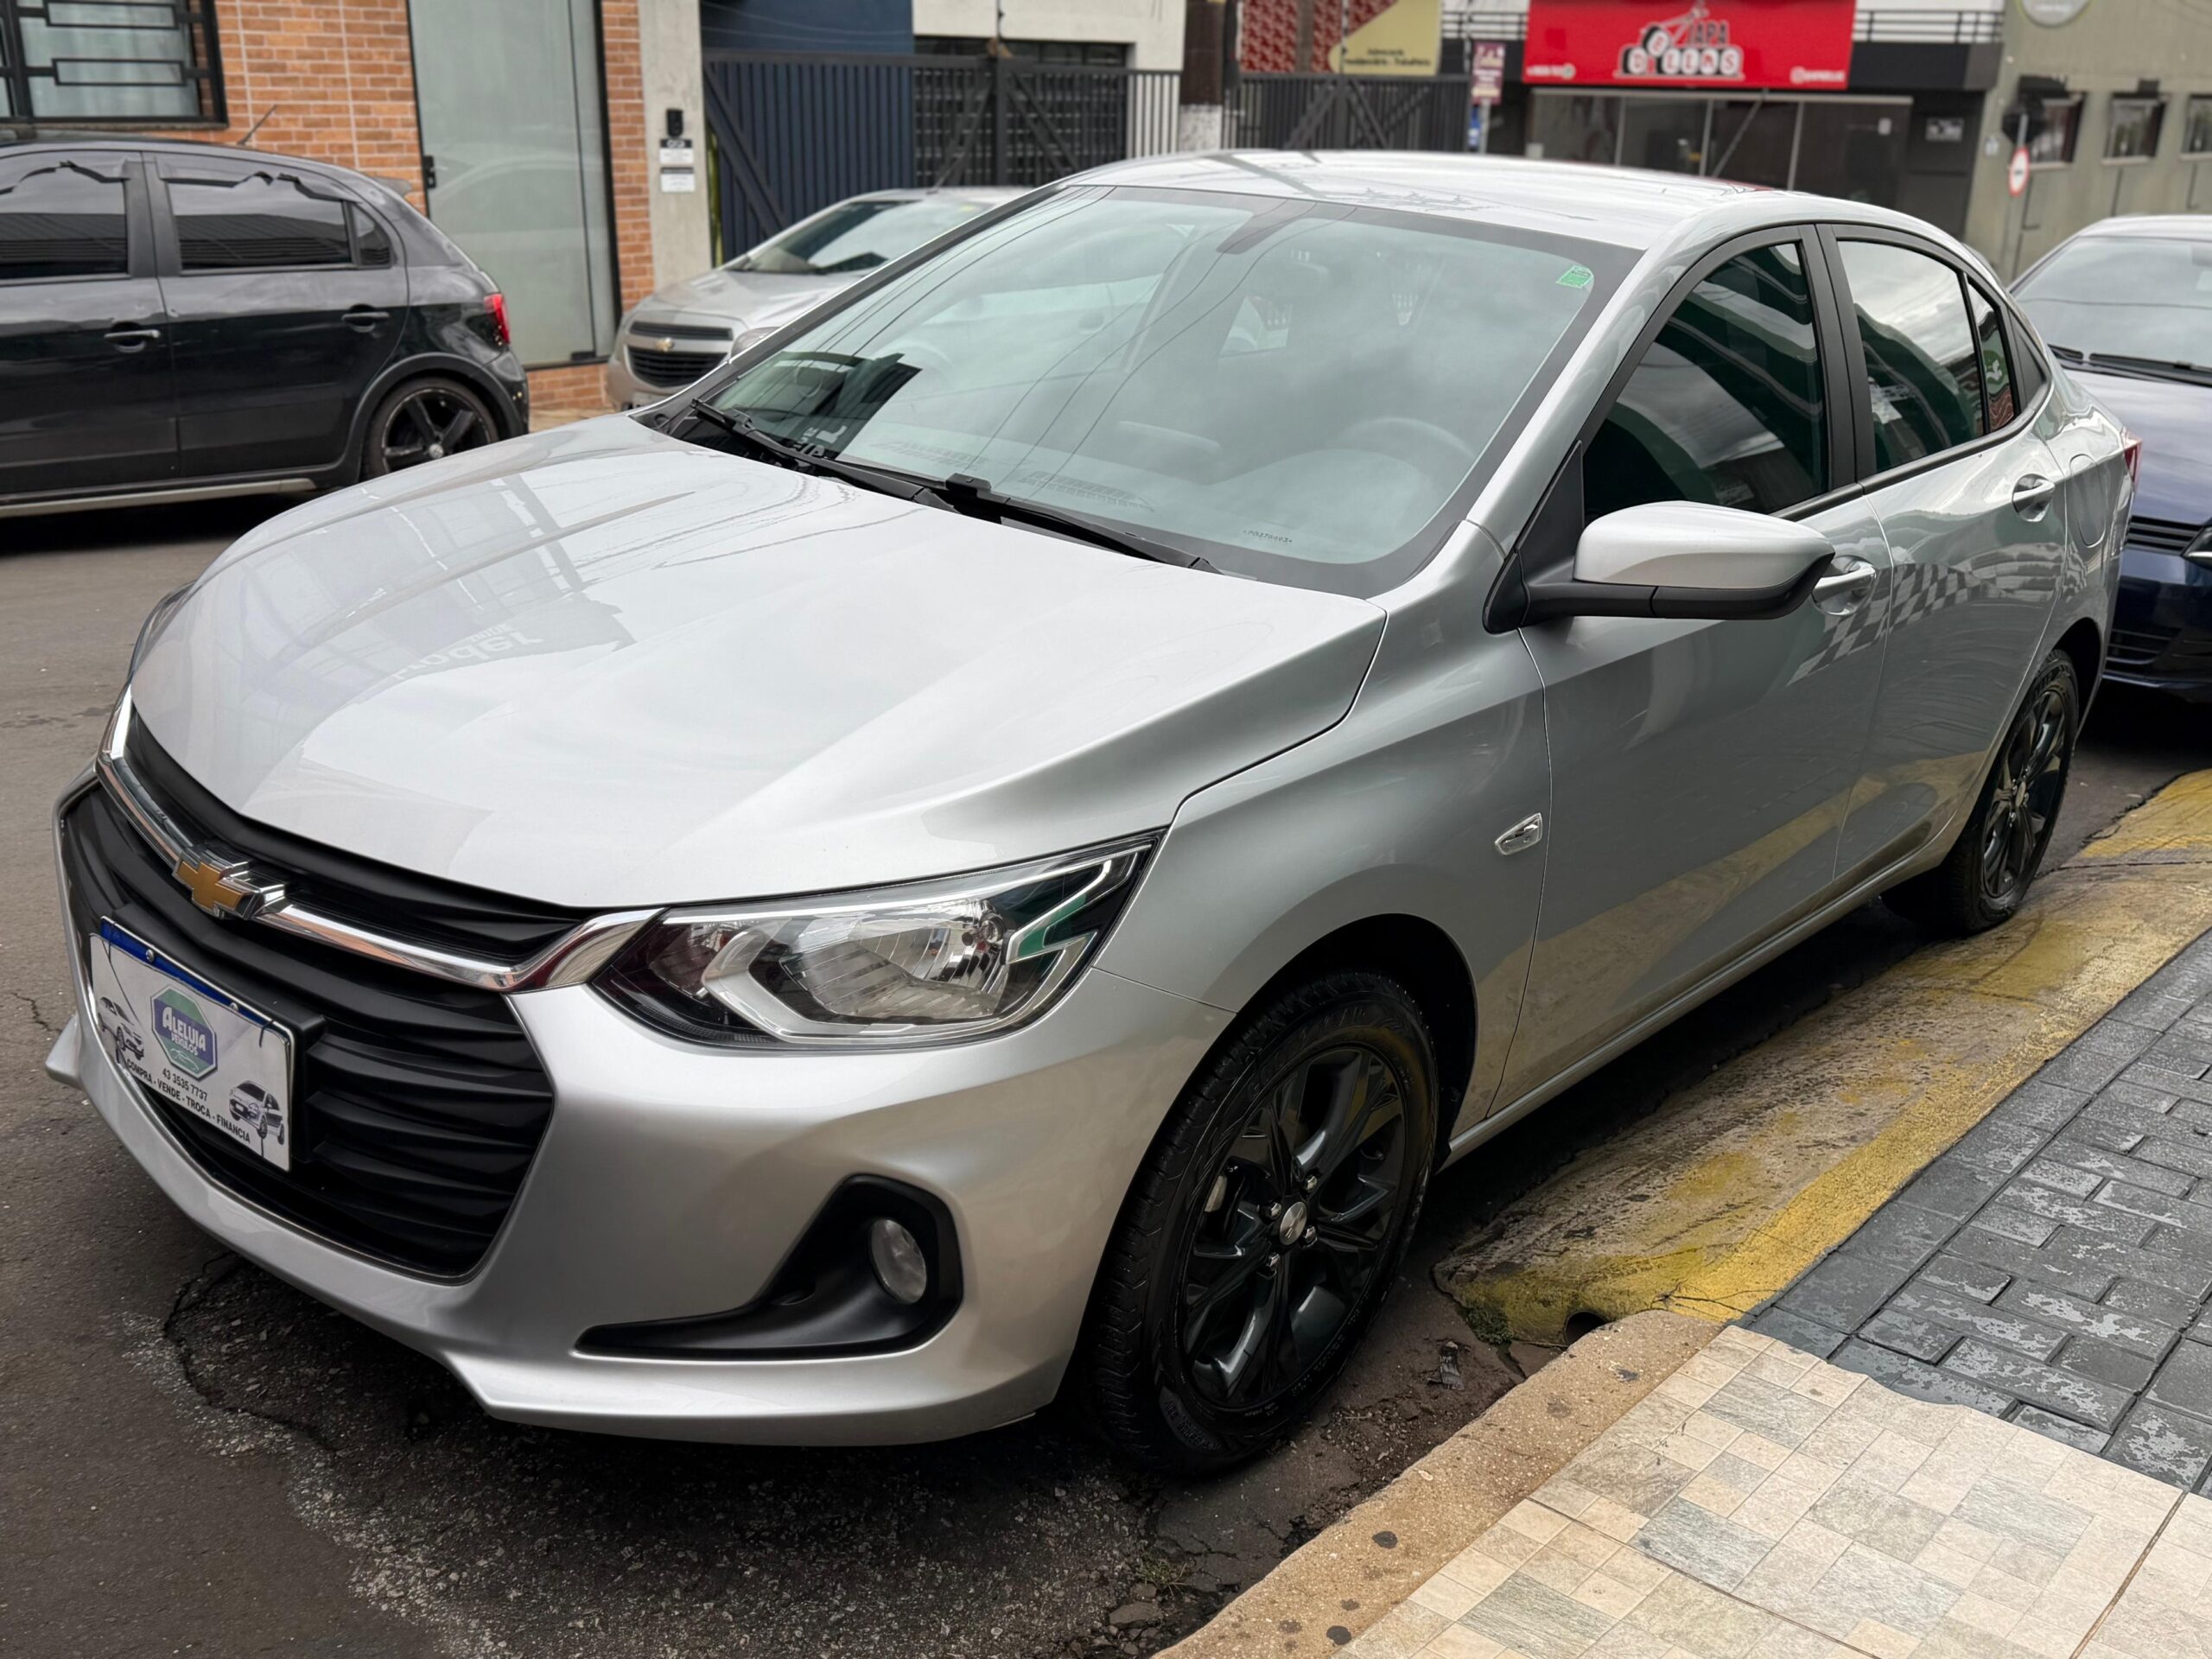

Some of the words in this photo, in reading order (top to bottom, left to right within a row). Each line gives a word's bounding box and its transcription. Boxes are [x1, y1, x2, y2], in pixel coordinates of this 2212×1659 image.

[126, 1058, 153, 1084] COMPRA
[157, 1078, 181, 1101] VENDE
[186, 1096, 211, 1119] TROCA
[217, 1114, 251, 1143] FINANCIA
[162, 1068, 171, 1079] 43
[190, 1084, 207, 1102] 7737
